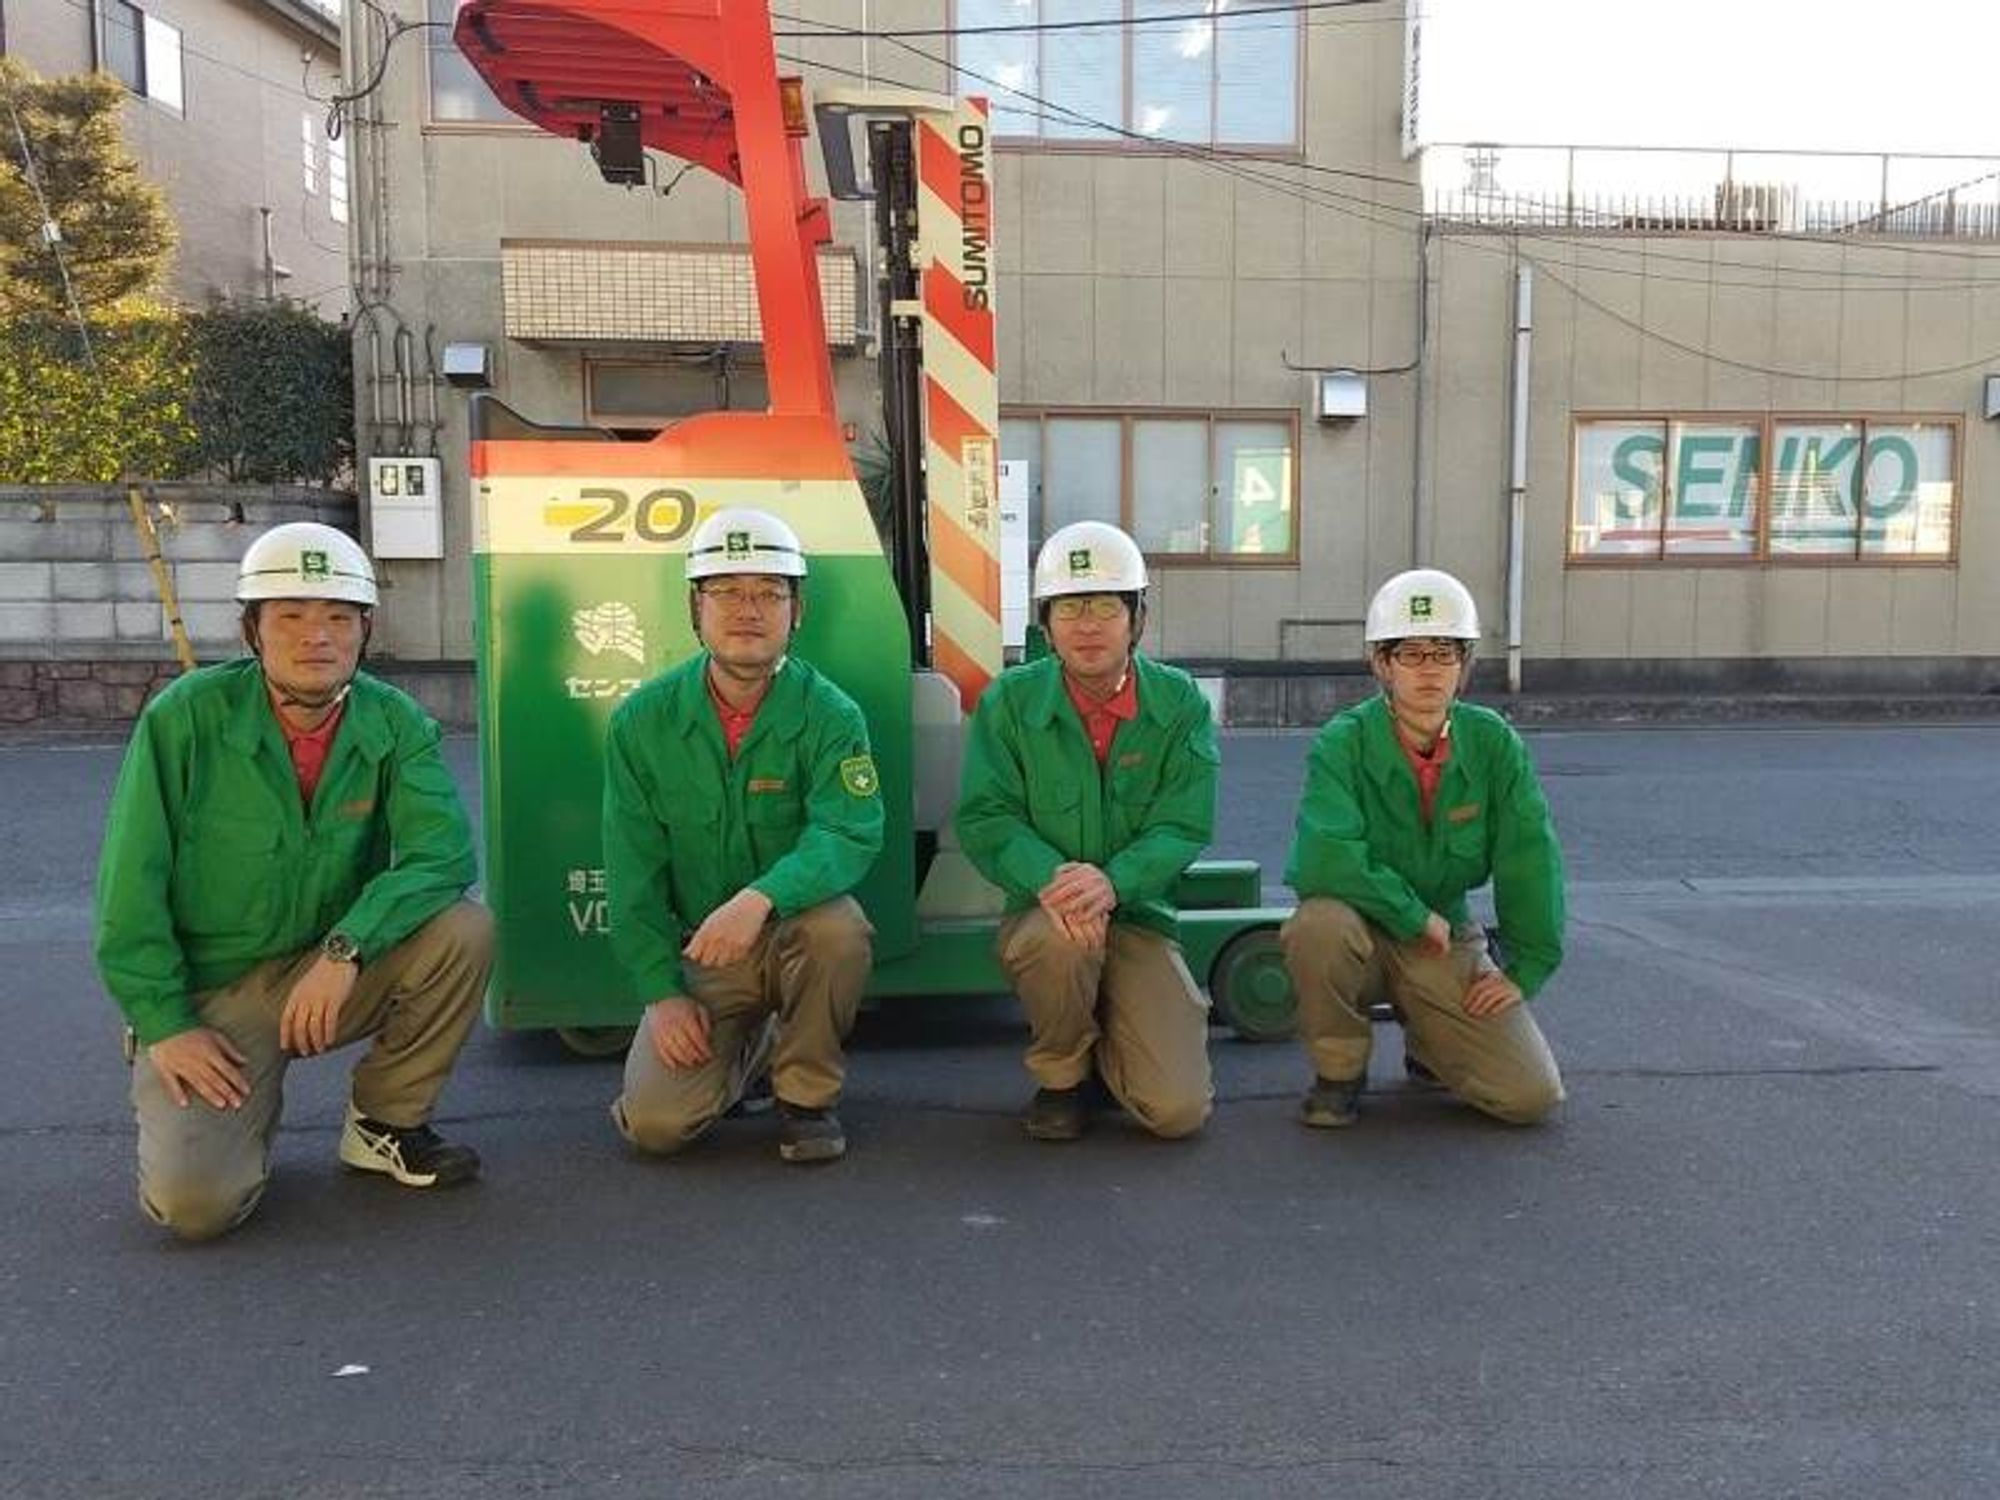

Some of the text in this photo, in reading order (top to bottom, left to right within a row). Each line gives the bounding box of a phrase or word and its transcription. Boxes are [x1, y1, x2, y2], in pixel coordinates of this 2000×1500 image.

[959, 125, 989, 312] SUMITOMO
[570, 488, 696, 541] 20
[1612, 435, 1918, 519] SENKO
